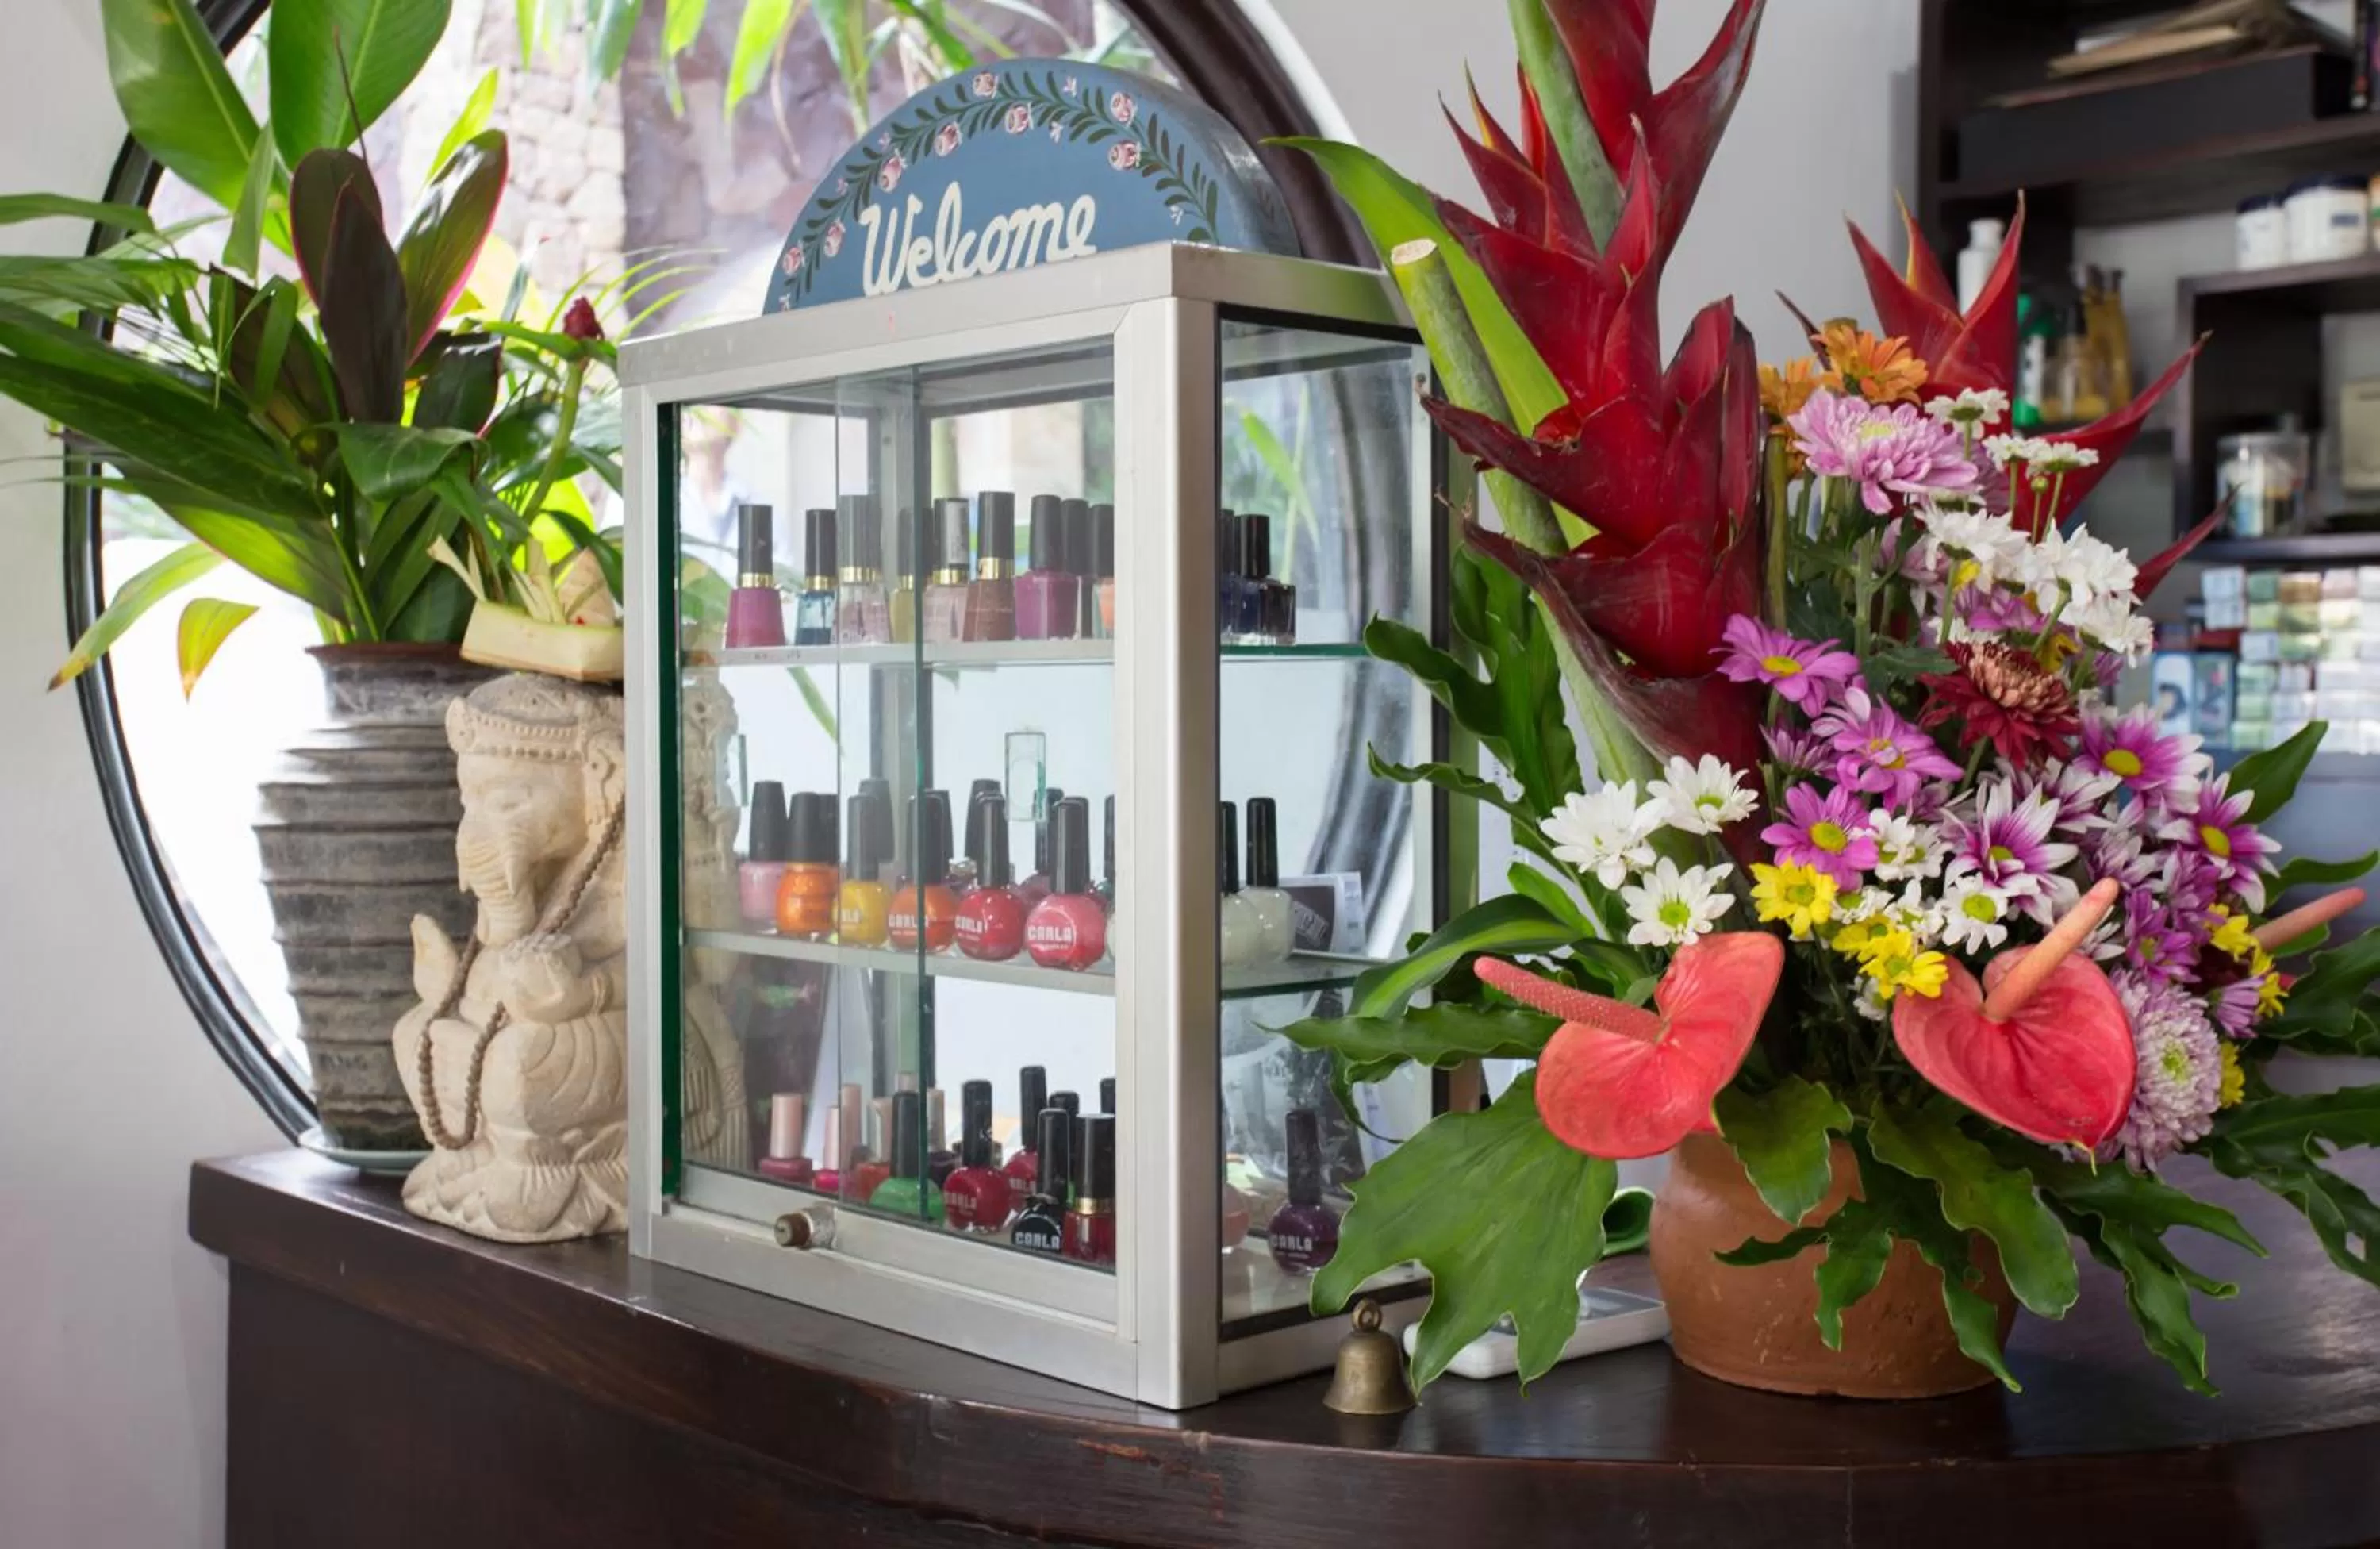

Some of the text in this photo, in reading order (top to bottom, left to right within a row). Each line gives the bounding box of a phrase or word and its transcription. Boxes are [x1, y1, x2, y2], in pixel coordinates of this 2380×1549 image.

[859, 181, 1096, 297] Welcome
[955, 915, 982, 934] CARLA
[1028, 925, 1072, 942] CARLA
[1015, 1232, 1060, 1250] CARLA
[1271, 1235, 1312, 1251] CARLA
